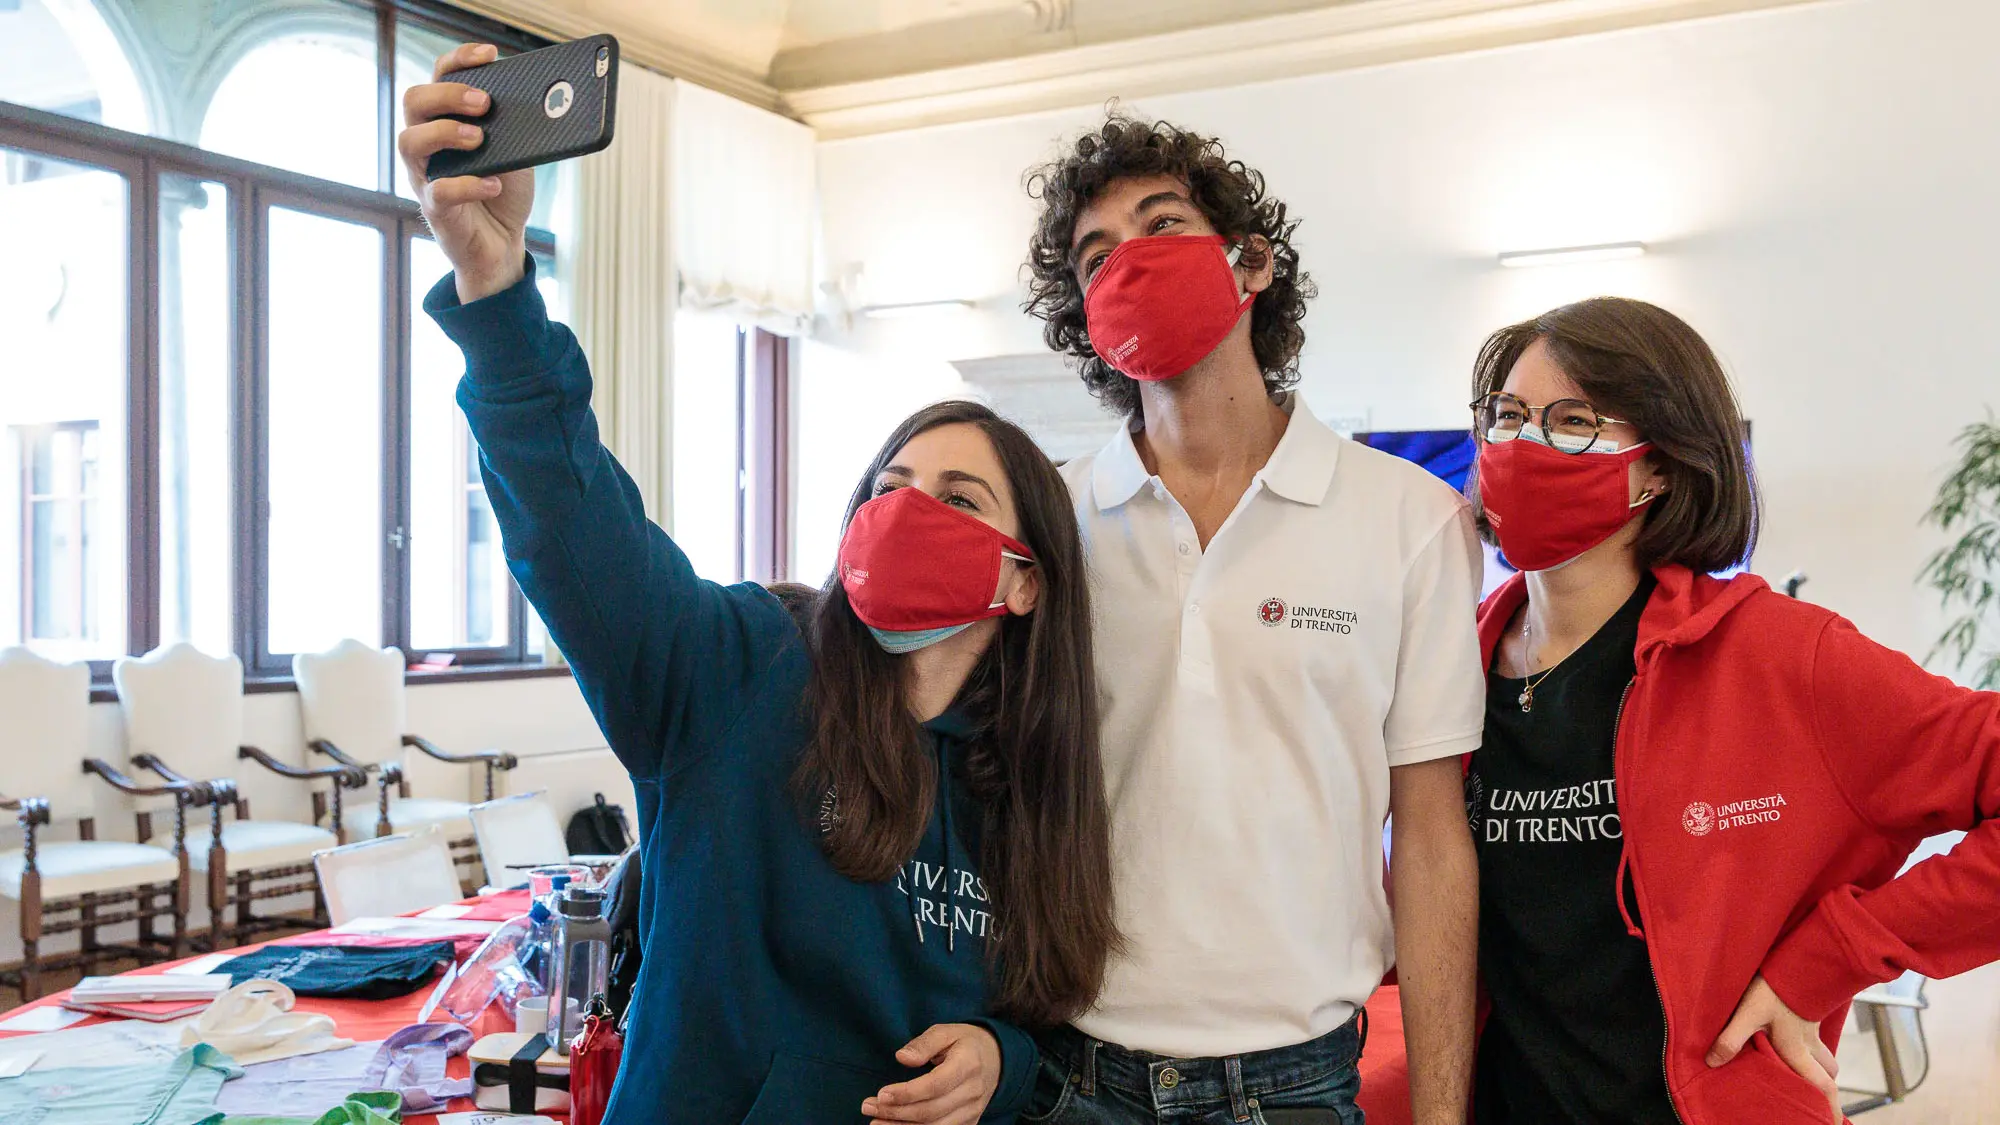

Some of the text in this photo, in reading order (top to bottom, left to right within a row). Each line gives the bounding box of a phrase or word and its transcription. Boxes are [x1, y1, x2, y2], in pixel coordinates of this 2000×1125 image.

[1290, 619, 1351, 635] DI TRENTO
[1292, 606, 1358, 625] UNIVERSITÀ
[1490, 779, 1616, 811] UNIVERSIT
[1717, 793, 1787, 817] UNIVERSITÀ
[1486, 813, 1623, 842] DI TRENTO
[1718, 817, 1730, 831] DI
[1730, 809, 1781, 827] TRENTO
